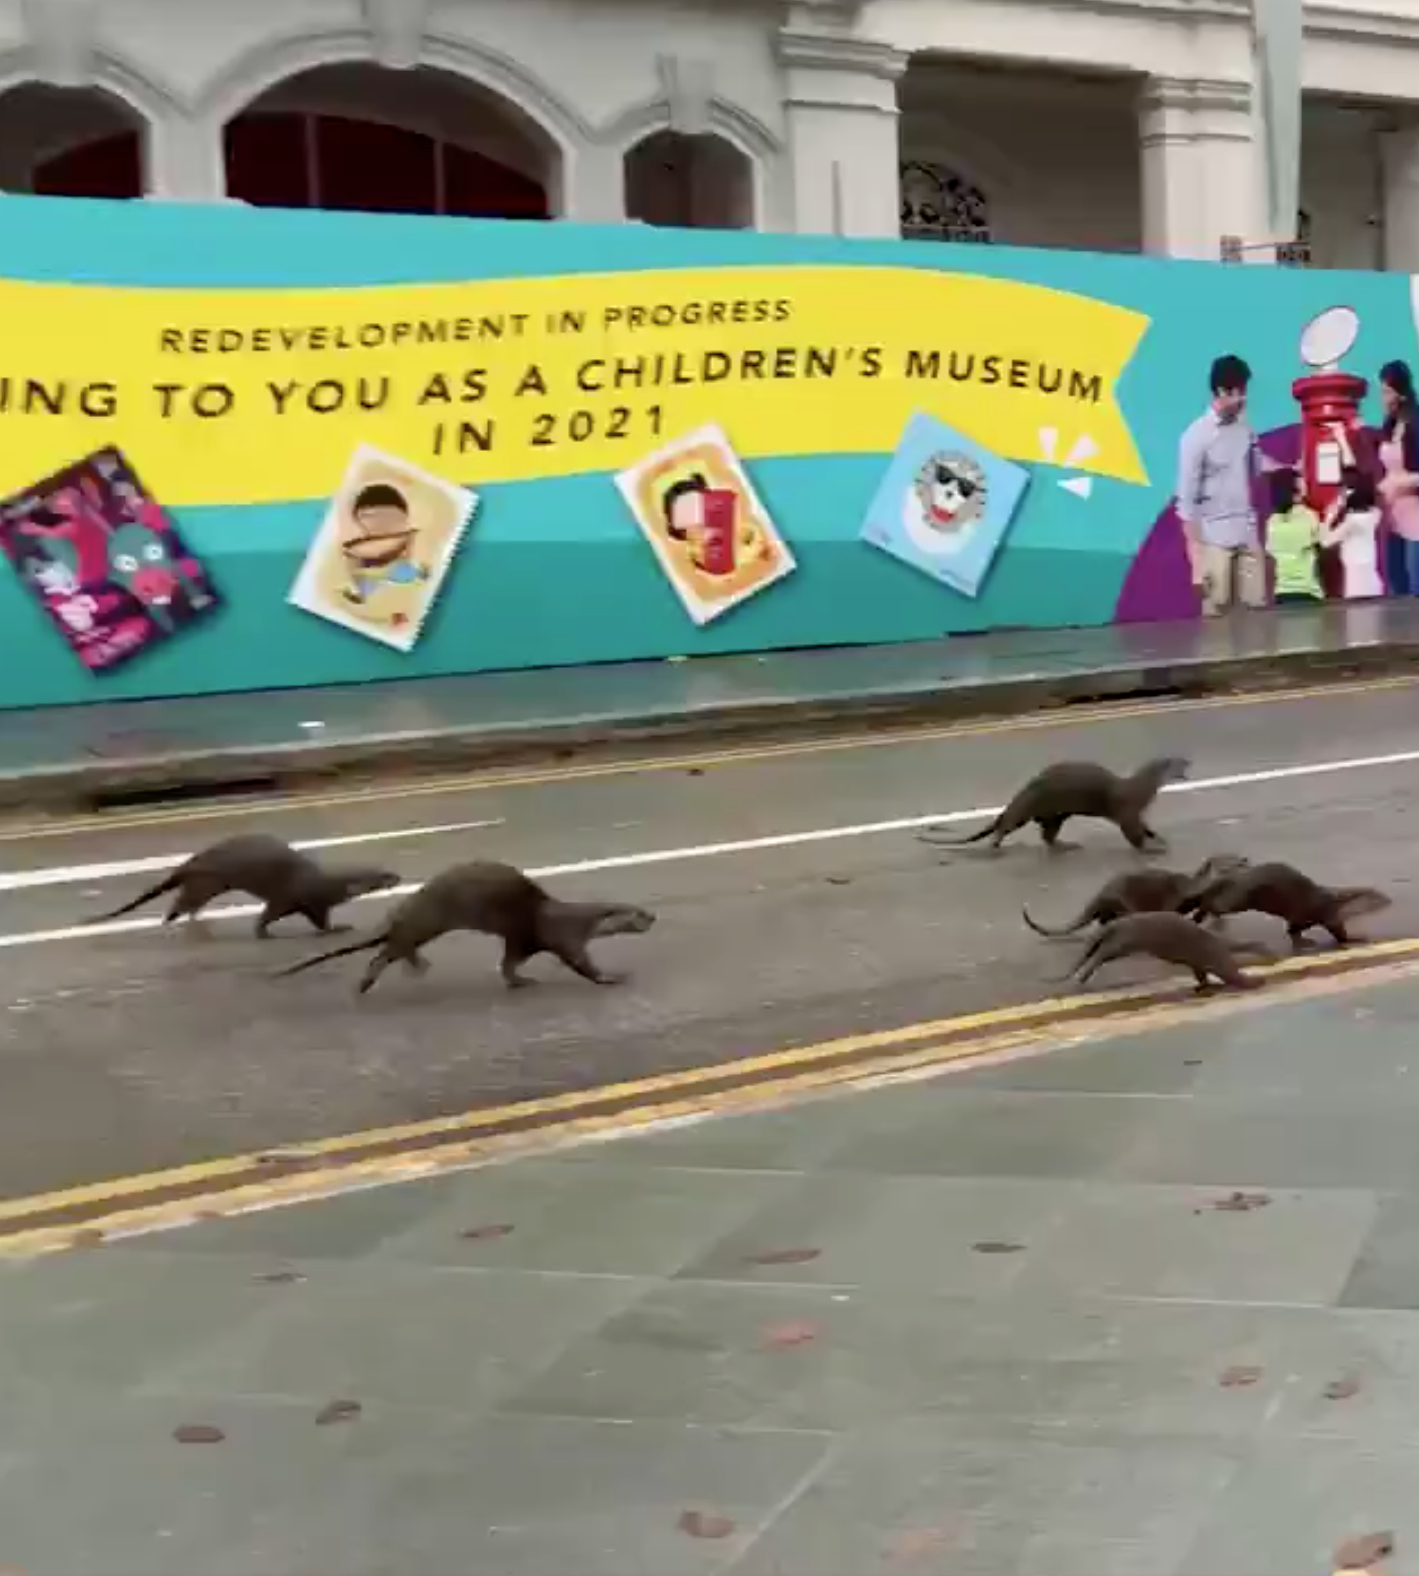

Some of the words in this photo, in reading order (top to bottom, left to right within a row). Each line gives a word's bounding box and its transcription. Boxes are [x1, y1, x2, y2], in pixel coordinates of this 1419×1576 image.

[160, 313, 529, 354] REDEVELOPMENT
[546, 310, 586, 334] IN
[603, 299, 790, 331] PROGRESS
[152, 384, 235, 419] TO
[267, 377, 389, 415] YOU
[418, 368, 488, 406] AS
[514, 365, 547, 397] A
[576, 345, 882, 392] CHILDREN'S
[904, 350, 1103, 403] MUSEUM
[432, 420, 494, 456] IN
[530, 405, 662, 446] 2021
